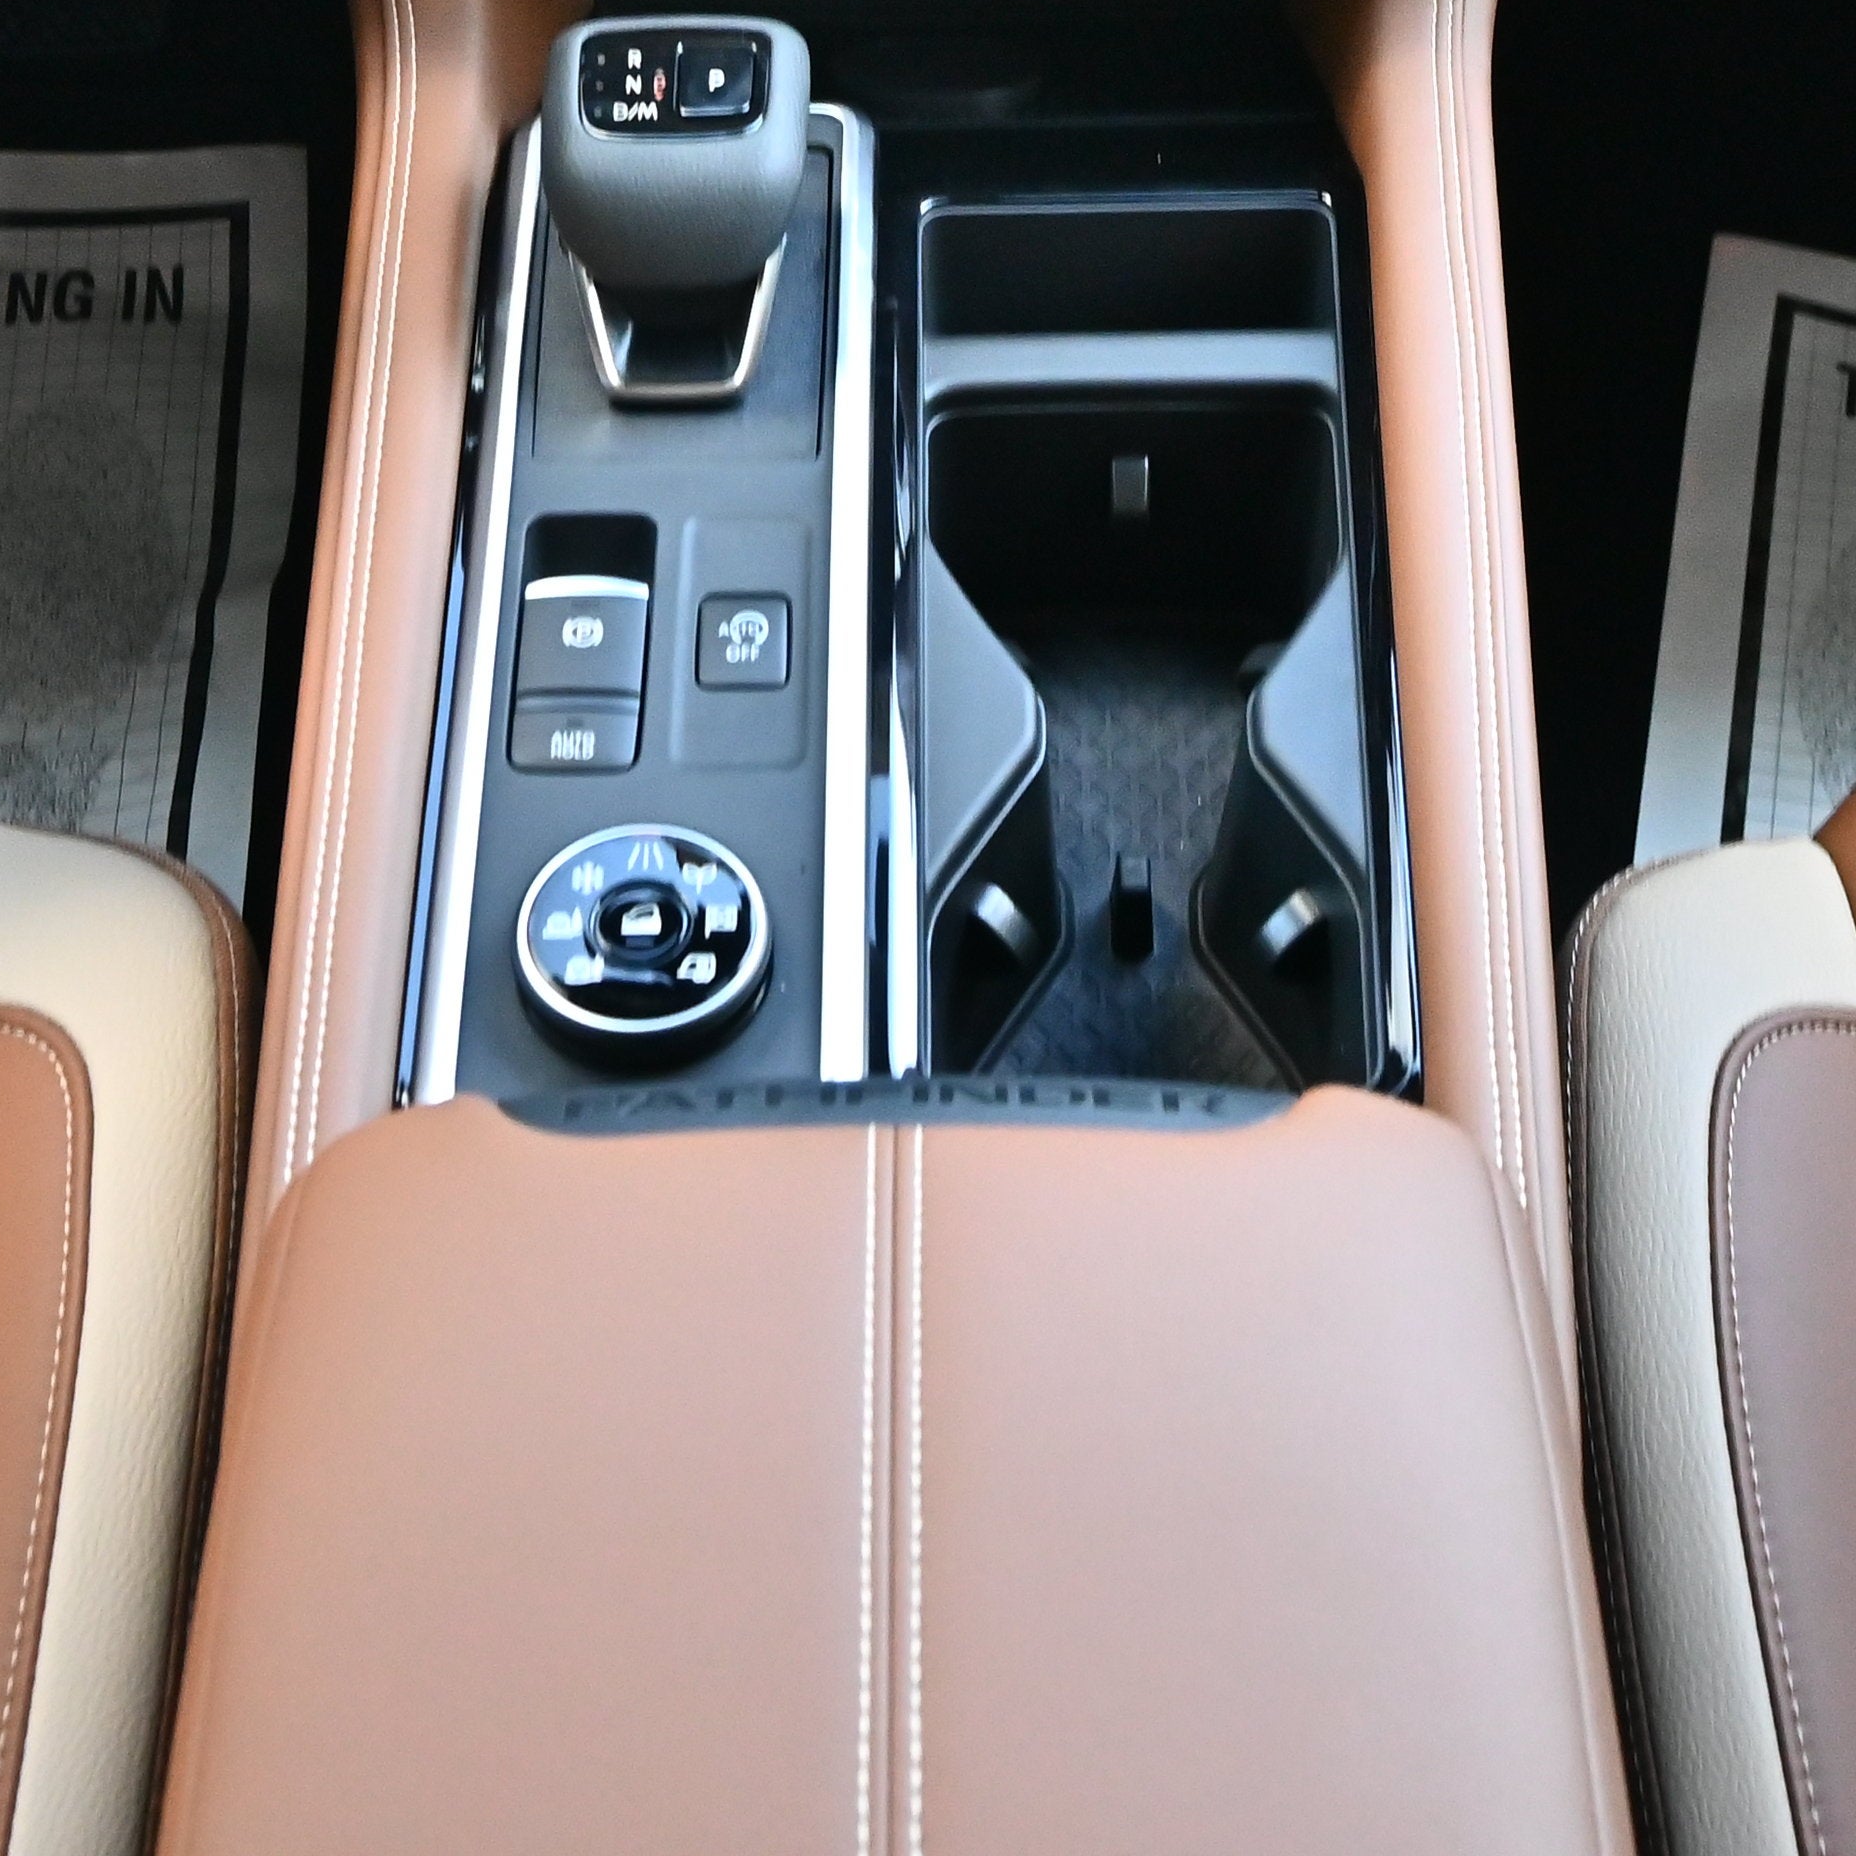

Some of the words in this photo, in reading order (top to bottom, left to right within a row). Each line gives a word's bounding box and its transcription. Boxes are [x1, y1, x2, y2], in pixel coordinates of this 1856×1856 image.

[627, 47, 643, 71] R
[624, 73, 643, 96] N
[708, 67, 726, 94] P
[612, 100, 659, 123] D/M
[121, 262, 185, 324] IN
[725, 643, 760, 664] OFF
[550, 729, 595, 761] AUTO
